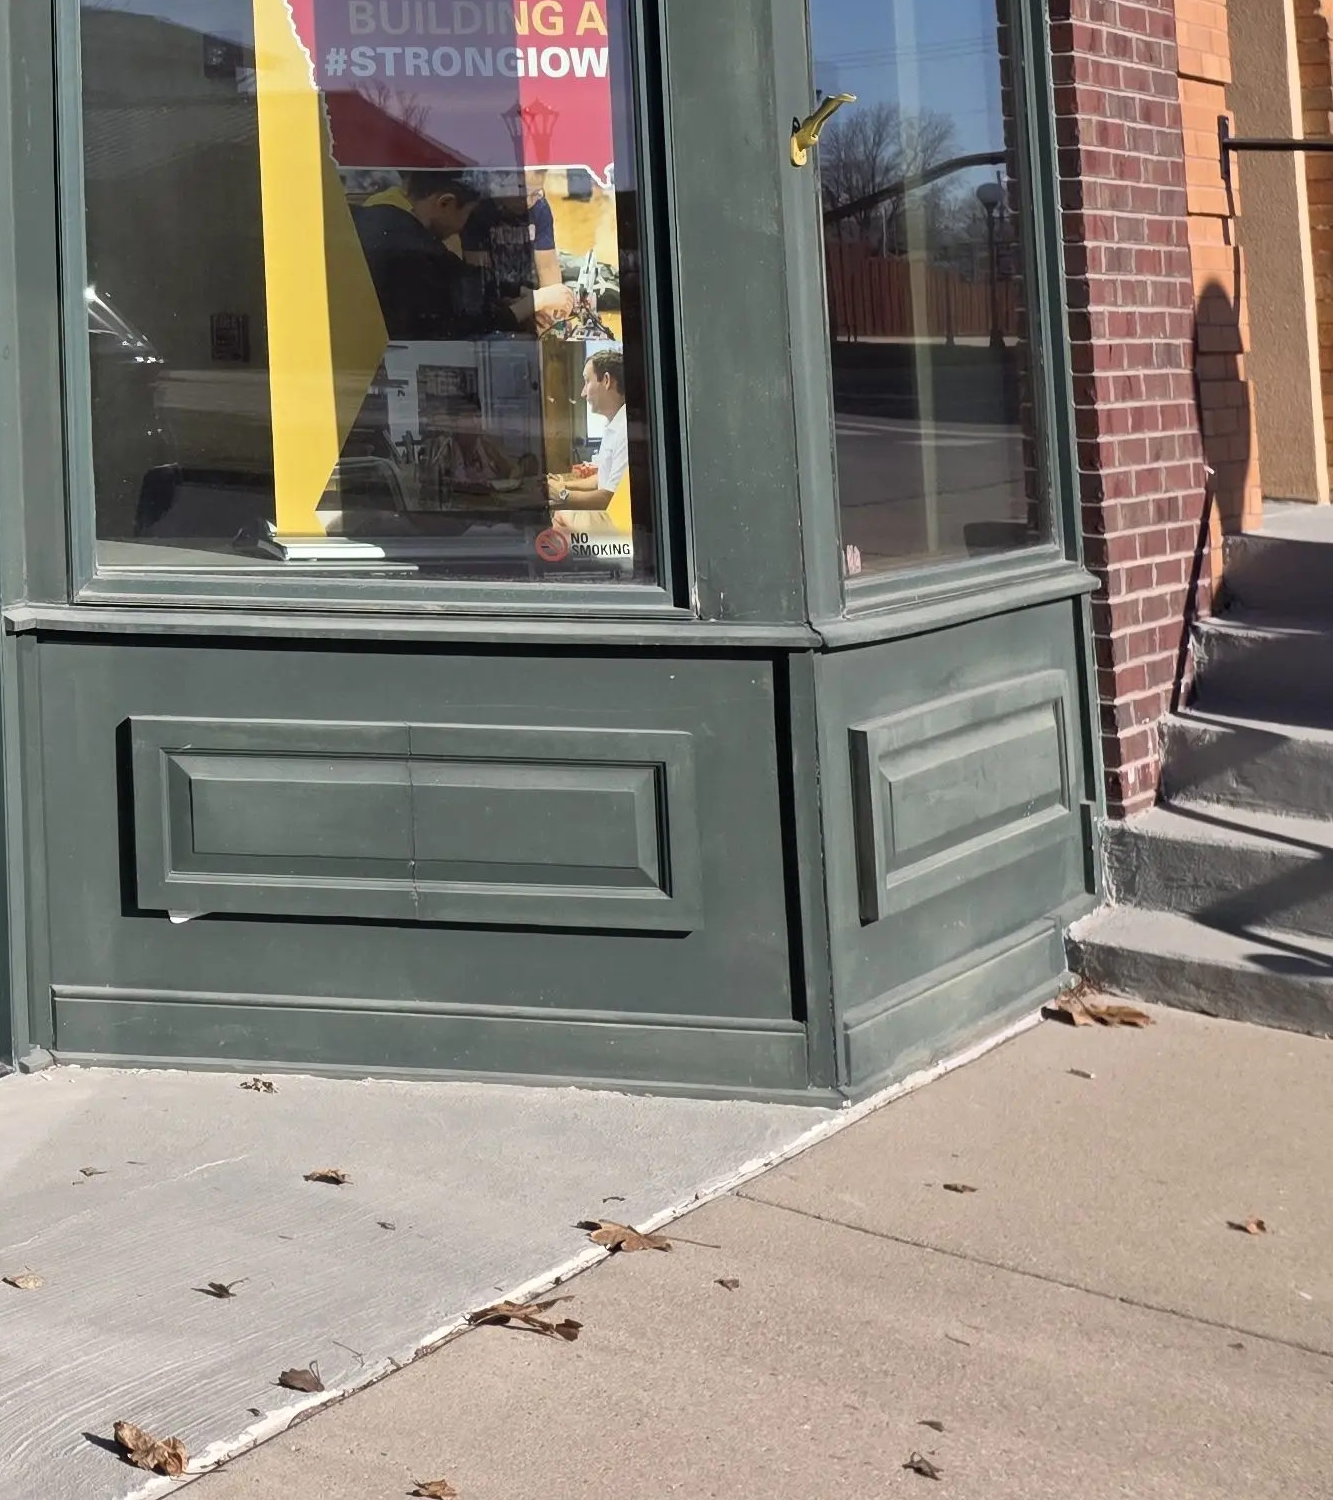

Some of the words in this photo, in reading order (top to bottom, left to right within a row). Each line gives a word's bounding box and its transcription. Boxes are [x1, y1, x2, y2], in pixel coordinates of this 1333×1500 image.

[348, 0, 564, 36] BUILDING
[576, 0, 608, 36] A
[570, 532, 589, 544] NO
[571, 543, 630, 557] SMOKING
